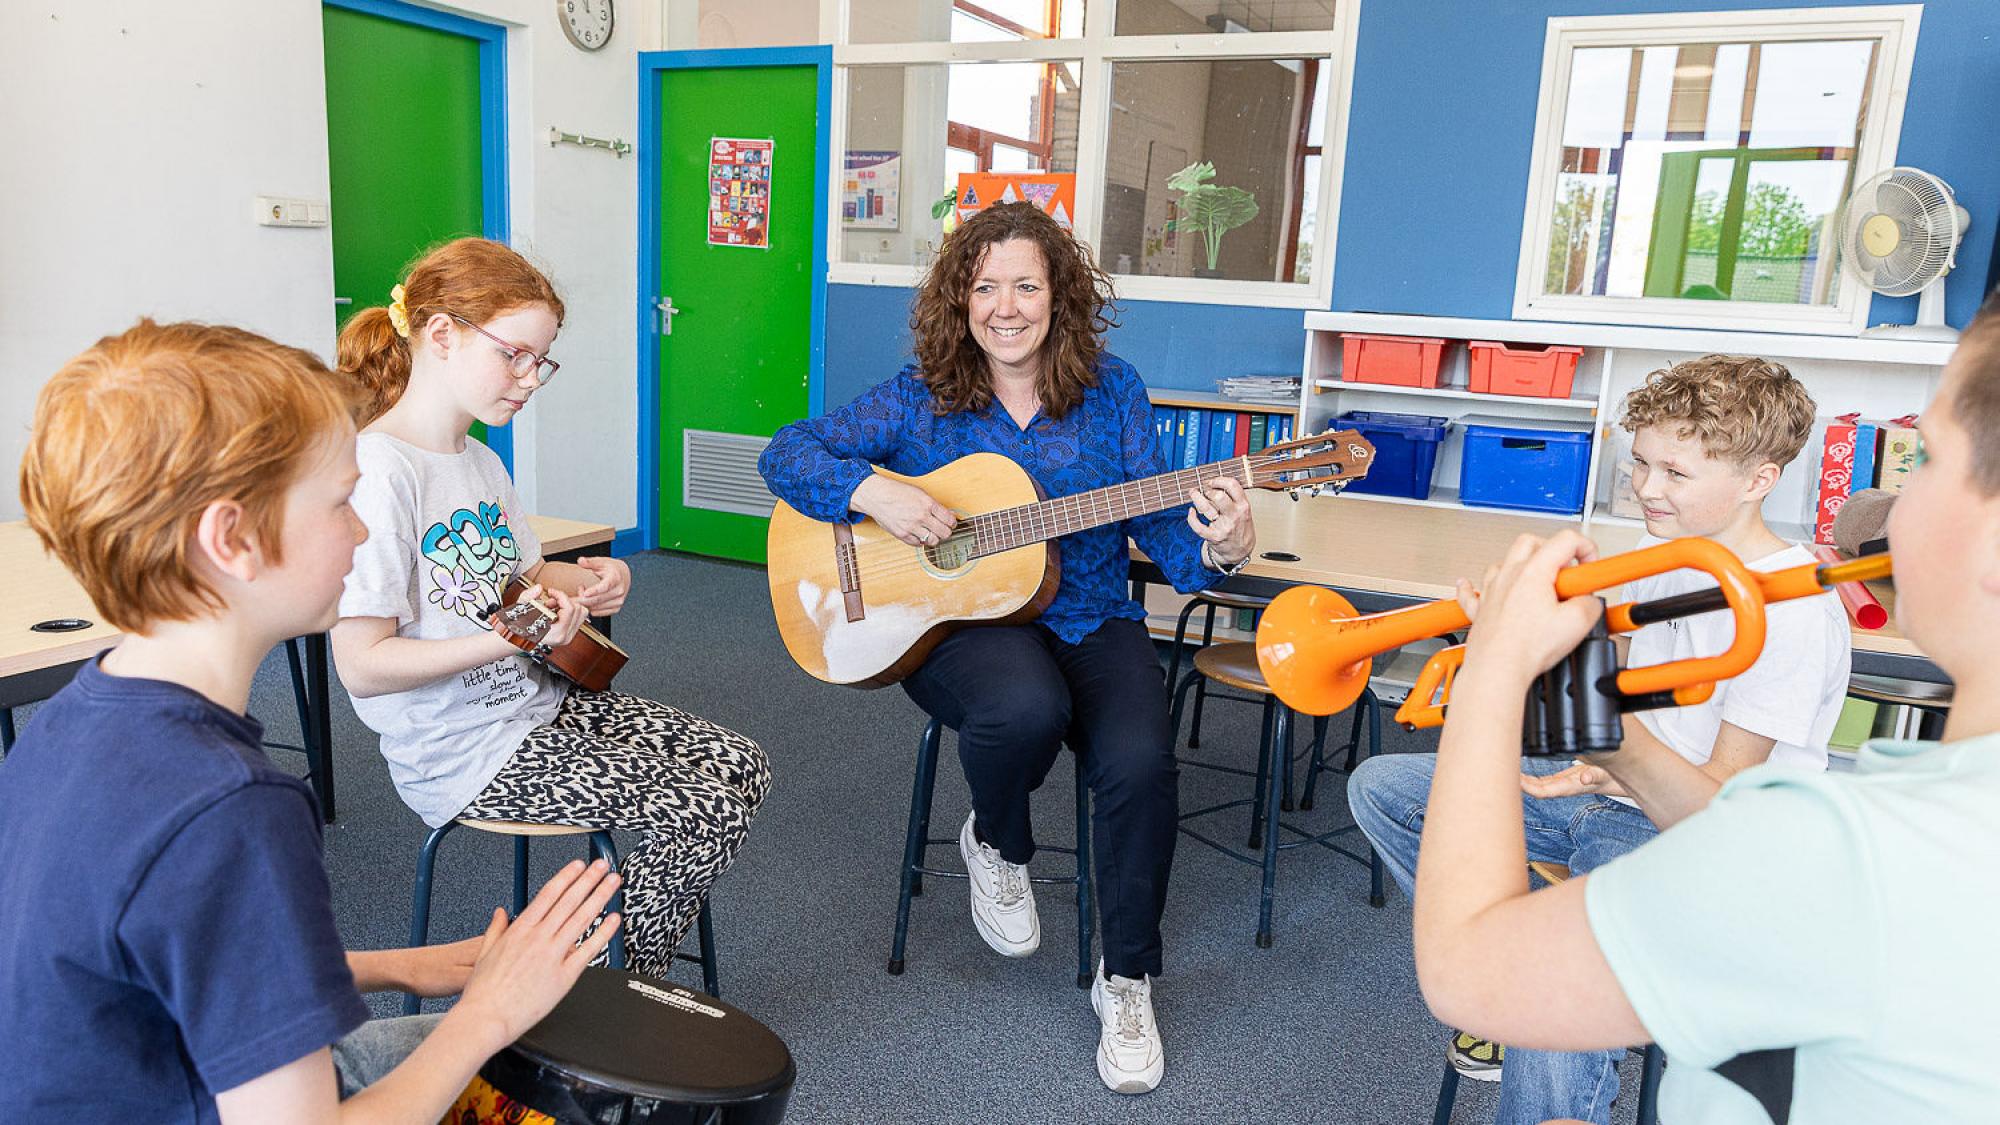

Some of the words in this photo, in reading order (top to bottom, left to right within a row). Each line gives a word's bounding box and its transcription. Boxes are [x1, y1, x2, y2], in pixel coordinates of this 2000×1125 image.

[567, 1, 574, 13] 9
[600, 10, 607, 21] 3
[585, 31, 592, 42] 6
[462, 668, 492, 688] little
[490, 679, 512, 690] slow
[485, 687, 528, 708] moment
